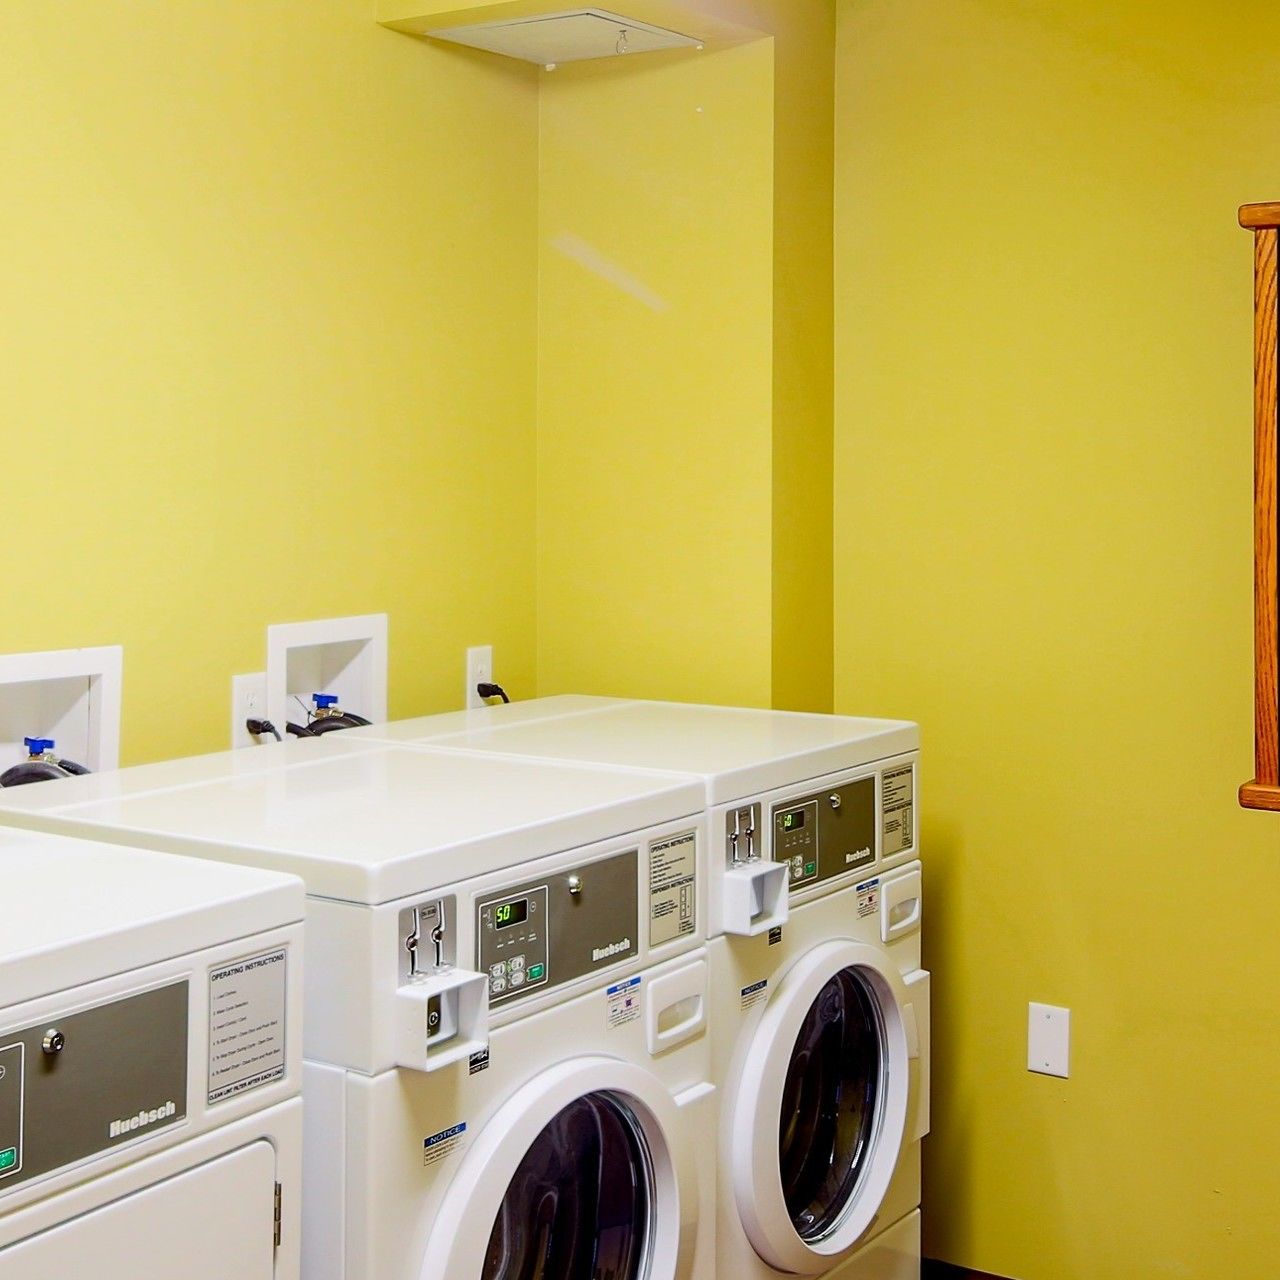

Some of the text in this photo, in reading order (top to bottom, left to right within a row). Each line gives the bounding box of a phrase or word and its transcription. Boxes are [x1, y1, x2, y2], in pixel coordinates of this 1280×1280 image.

[497, 905, 511, 922] 50
[592, 937, 631, 962] Huebsch
[211, 953, 284, 982] OPERATING INSTRUCTIONS
[109, 1100, 176, 1138] Huebsch
[429, 1125, 461, 1144] NOTICE
